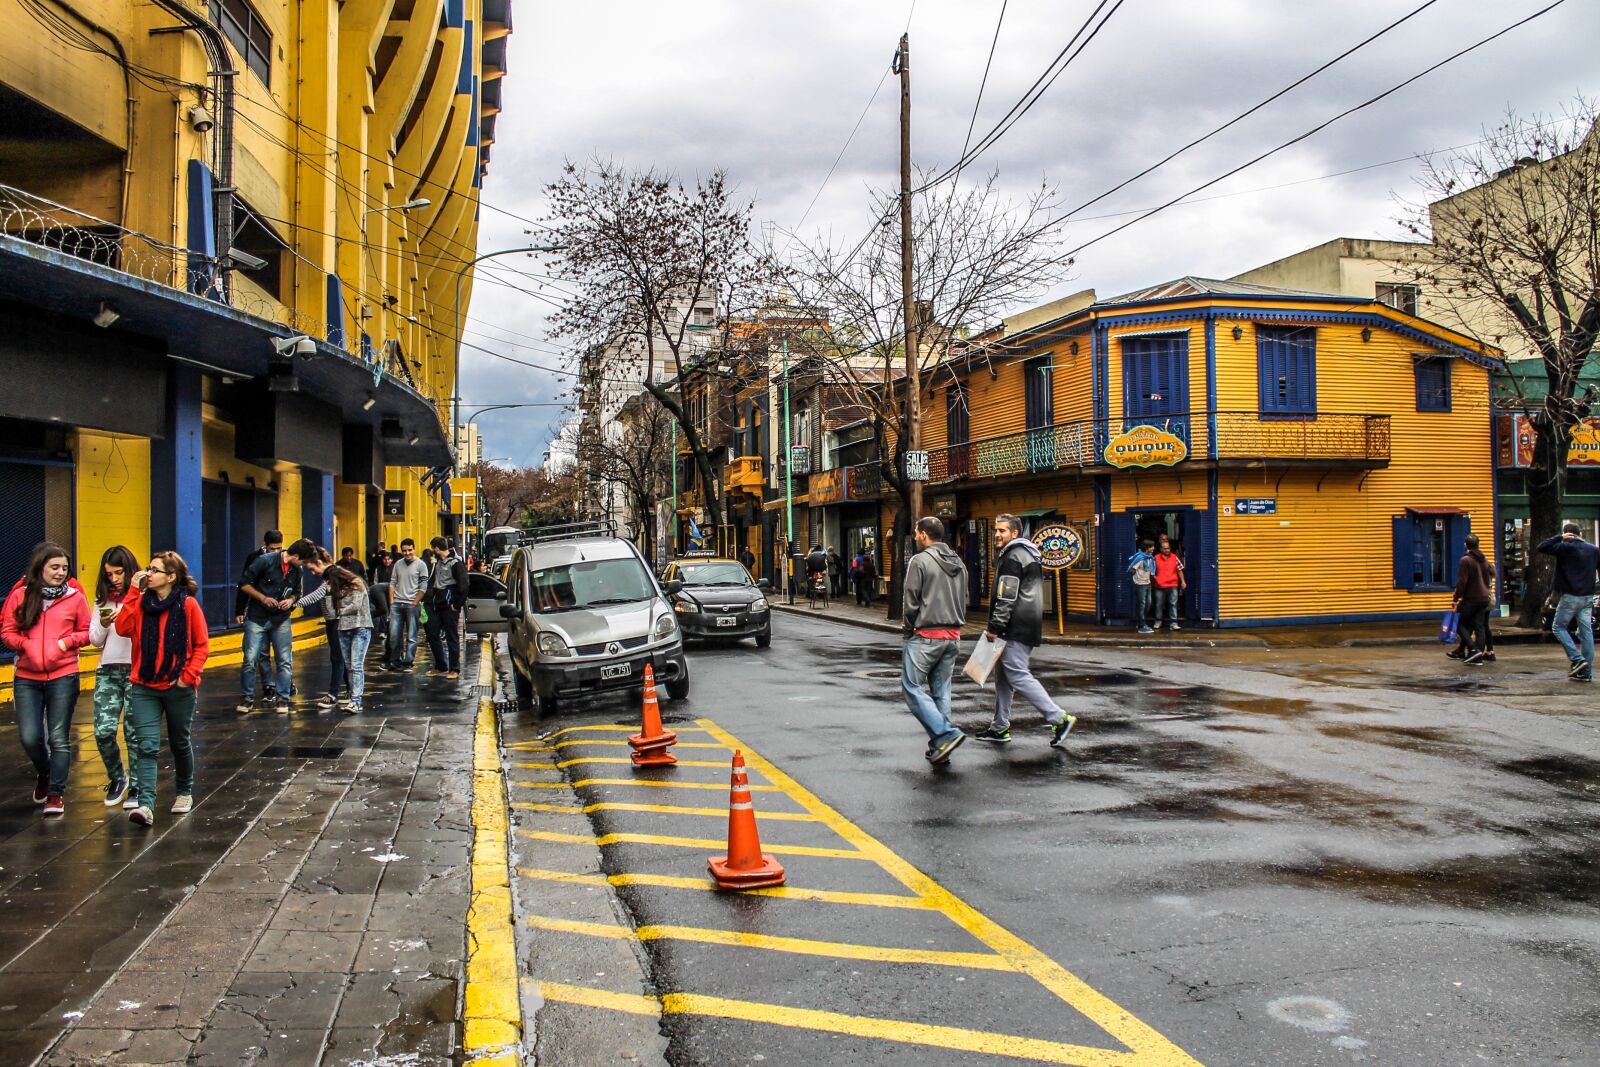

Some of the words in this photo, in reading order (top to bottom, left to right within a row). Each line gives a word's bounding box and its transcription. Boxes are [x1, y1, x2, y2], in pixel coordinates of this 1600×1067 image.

[1115, 442, 1175, 455] QUIQUE
[906, 464, 929, 476] DROGA
[1034, 527, 1077, 547] QUIQUE
[1041, 555, 1072, 566] MUSEUM
[602, 668, 615, 677] LUC
[617, 666, 629, 675] 791
